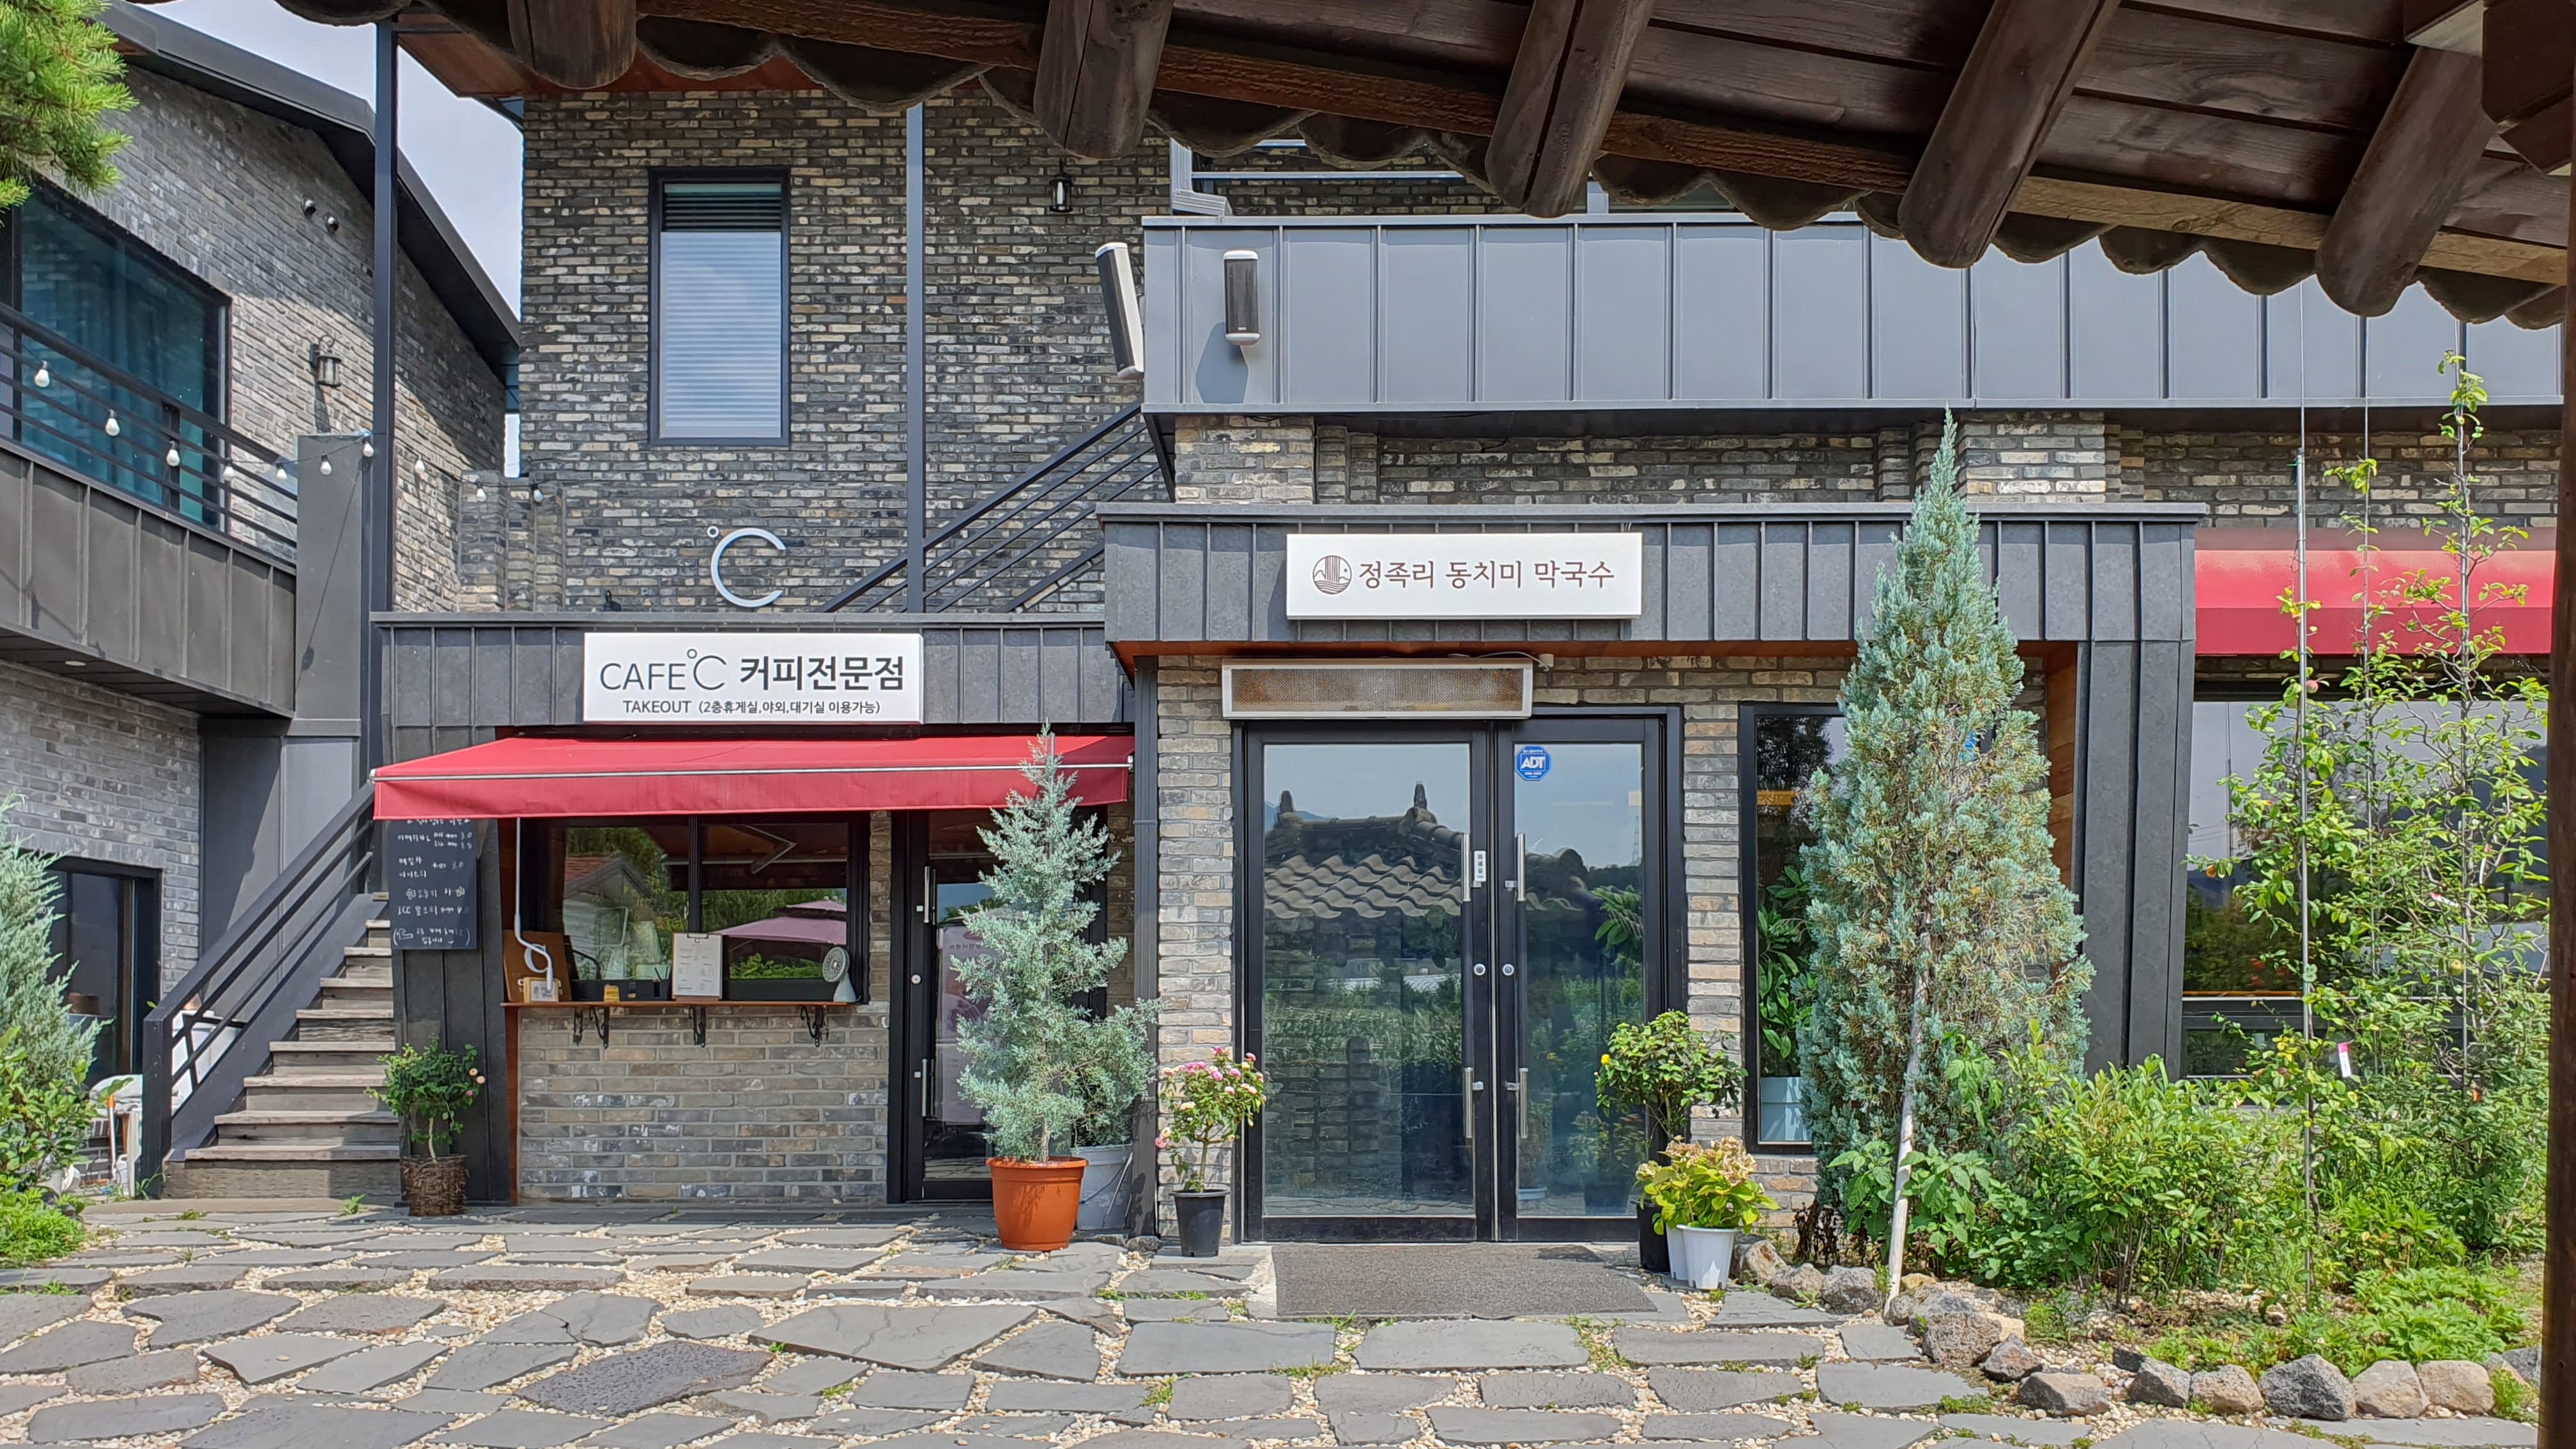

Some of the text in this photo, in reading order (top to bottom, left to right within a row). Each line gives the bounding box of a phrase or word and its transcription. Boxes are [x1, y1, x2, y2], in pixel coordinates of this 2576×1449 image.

[1359, 560, 1614, 589] 정족리 동치미 막국수
[740, 656, 903, 691] 커피전문점
[622, 700, 692, 714] TAKEOUT
[829, 700, 880, 714] 이용가능)
[1521, 756, 1545, 769] ADT
